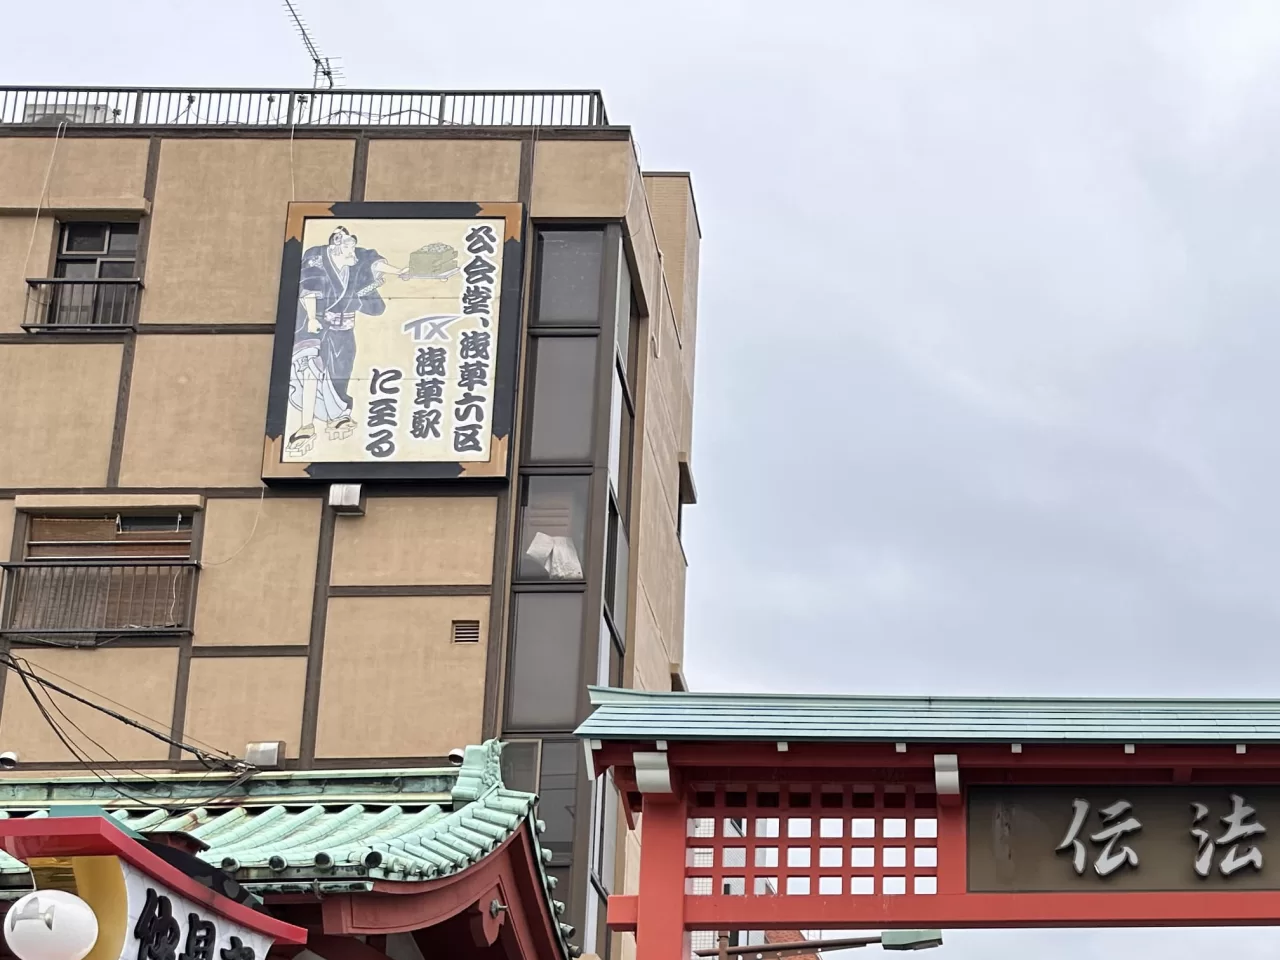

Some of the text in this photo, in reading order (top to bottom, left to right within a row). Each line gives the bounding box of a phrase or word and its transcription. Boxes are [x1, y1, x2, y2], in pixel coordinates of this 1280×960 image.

[453, 225, 497, 453] 公会堂、浅草六区
[366, 368, 402, 458] に至る
[411, 347, 447, 439] 浅草駅
